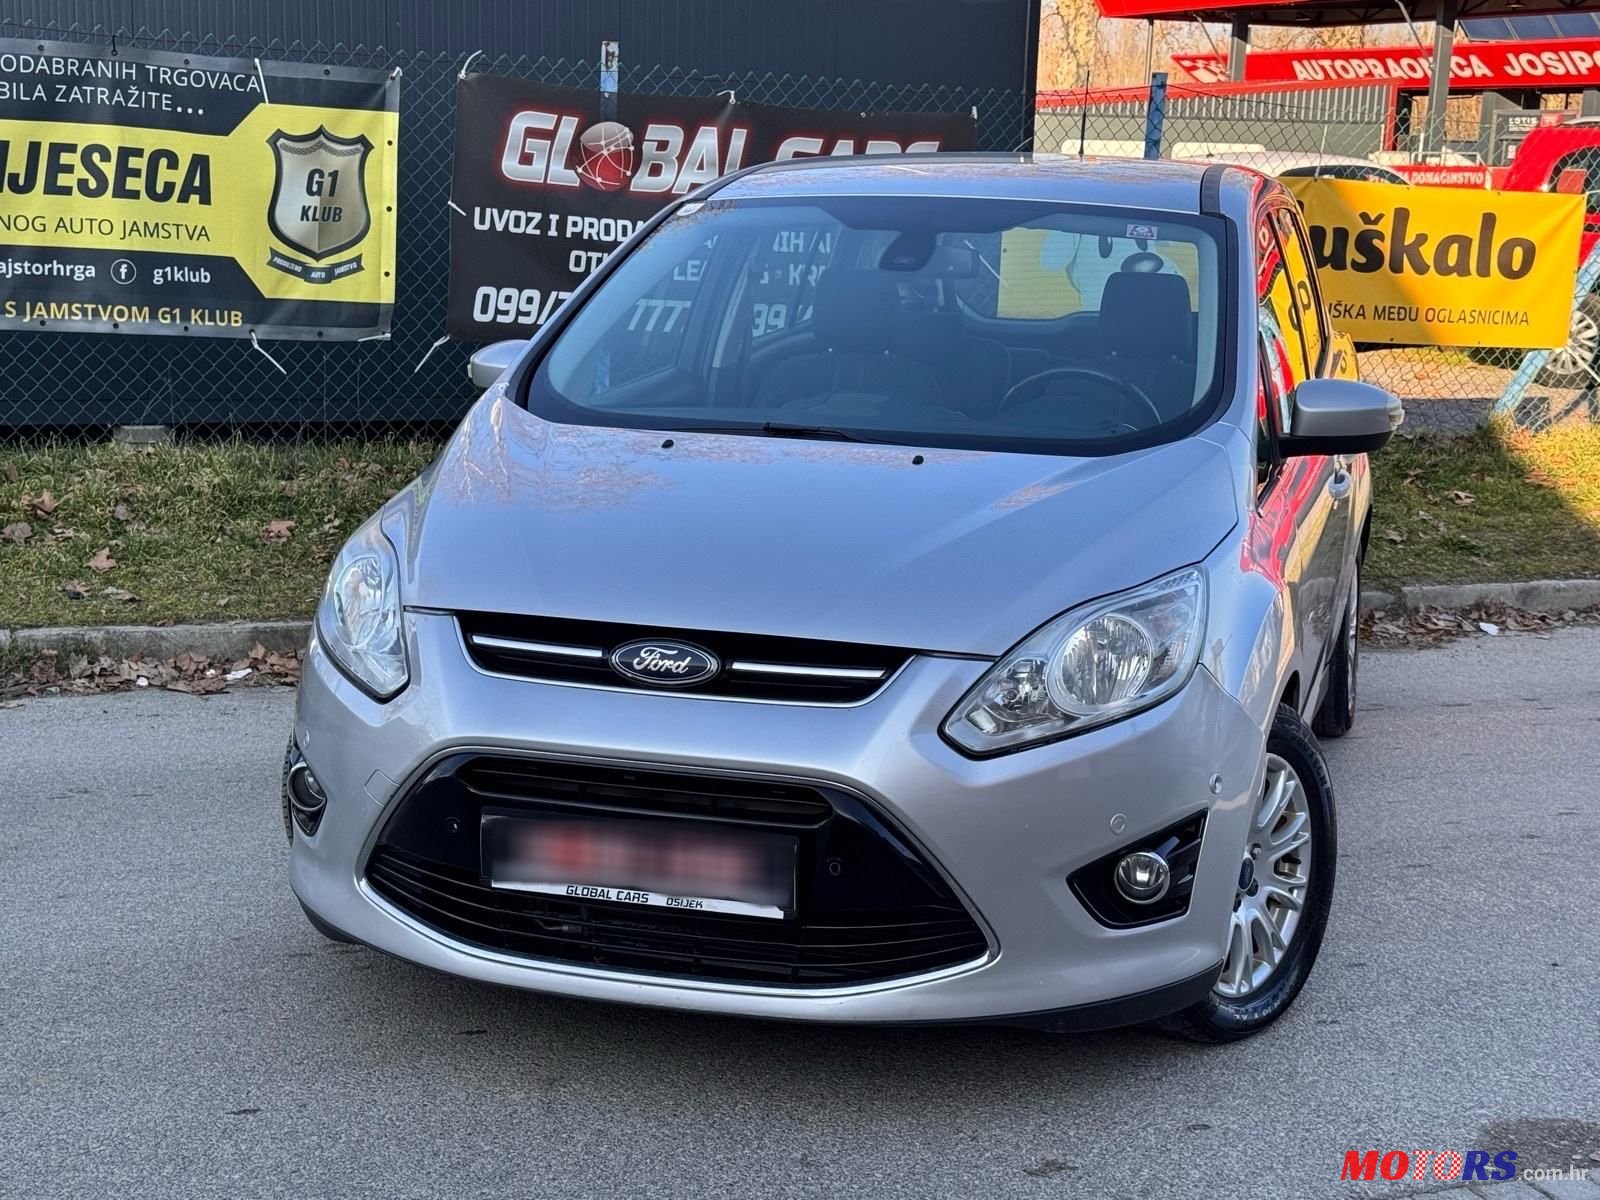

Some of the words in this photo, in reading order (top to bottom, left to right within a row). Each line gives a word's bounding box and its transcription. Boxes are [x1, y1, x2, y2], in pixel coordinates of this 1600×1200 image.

[0, 54, 137, 80] ODABRANIH
[145, 65, 260, 93] TRGOVACA
[1292, 54, 1494, 81] AUTOPRAOCA
[0, 81, 47, 102] BILA
[305, 168, 340, 198] G1
[300, 204, 343, 223] KLUB
[473, 206, 543, 236] UVOZ
[547, 213, 560, 237] I
[54, 217, 114, 236] AUTO
[119, 220, 211, 242] JAMSTVA
[1297, 200, 1537, 281] uškalo
[152, 265, 212, 285] g1klub
[310, 271, 326, 279] AUTO
[4, 300, 17, 319] S
[22, 301, 150, 324] JAMSTVOM
[157, 307, 181, 325] G1
[190, 308, 244, 327] KLUB
[1424, 307, 1530, 326] OGLASNICIMA
[632, 646, 690, 675] Ford
[565, 884, 613, 900] GLOBAL
[616, 890, 650, 904] CARS
[665, 896, 704, 909] OSIJEK
